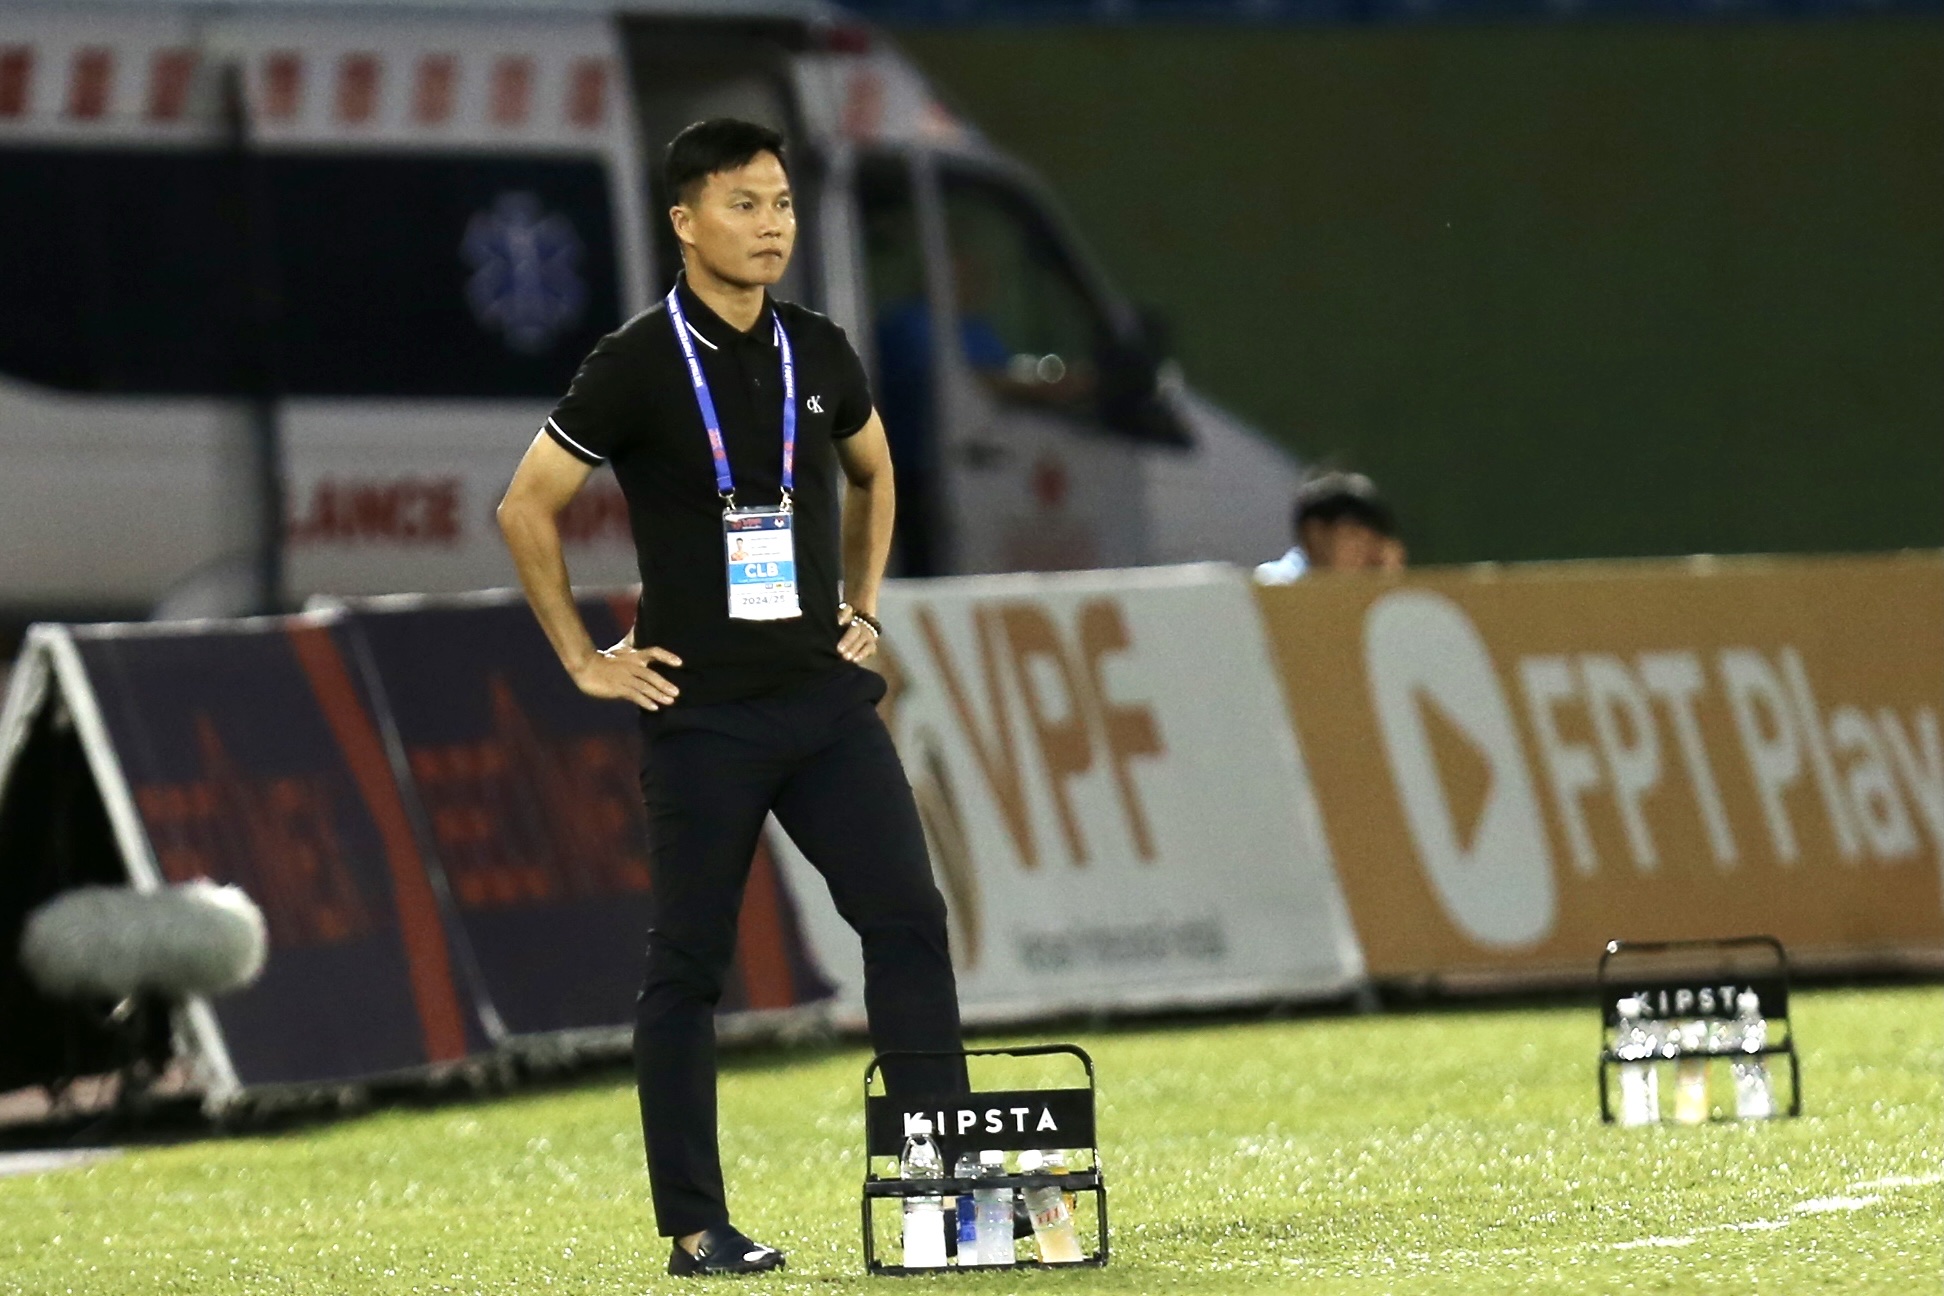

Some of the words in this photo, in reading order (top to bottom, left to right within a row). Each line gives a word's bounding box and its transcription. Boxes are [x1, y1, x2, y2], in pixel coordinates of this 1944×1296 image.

[744, 561, 779, 578] CLB
[912, 597, 1166, 872] VPF
[1516, 648, 1738, 878] FPT
[1717, 643, 1944, 910] Play
